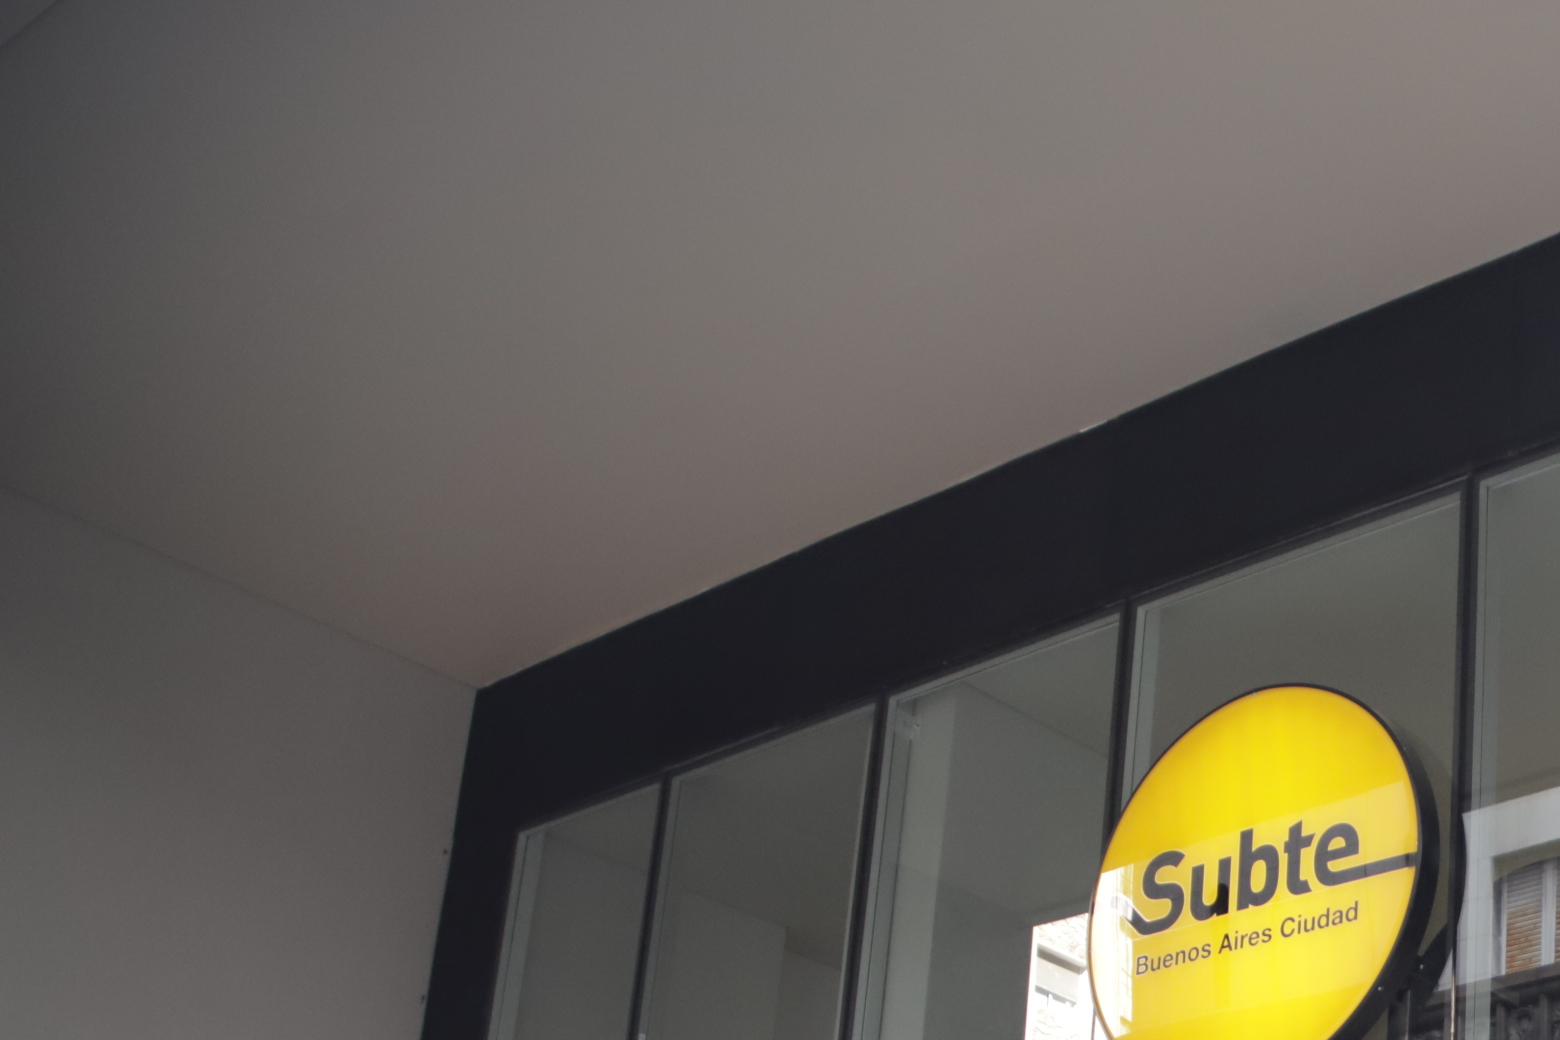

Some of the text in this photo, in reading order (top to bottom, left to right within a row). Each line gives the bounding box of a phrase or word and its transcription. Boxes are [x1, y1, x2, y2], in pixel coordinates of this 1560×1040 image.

[1122, 820, 1415, 936] Subte
[1134, 900, 1360, 977] Buenos Aires Ciudad
